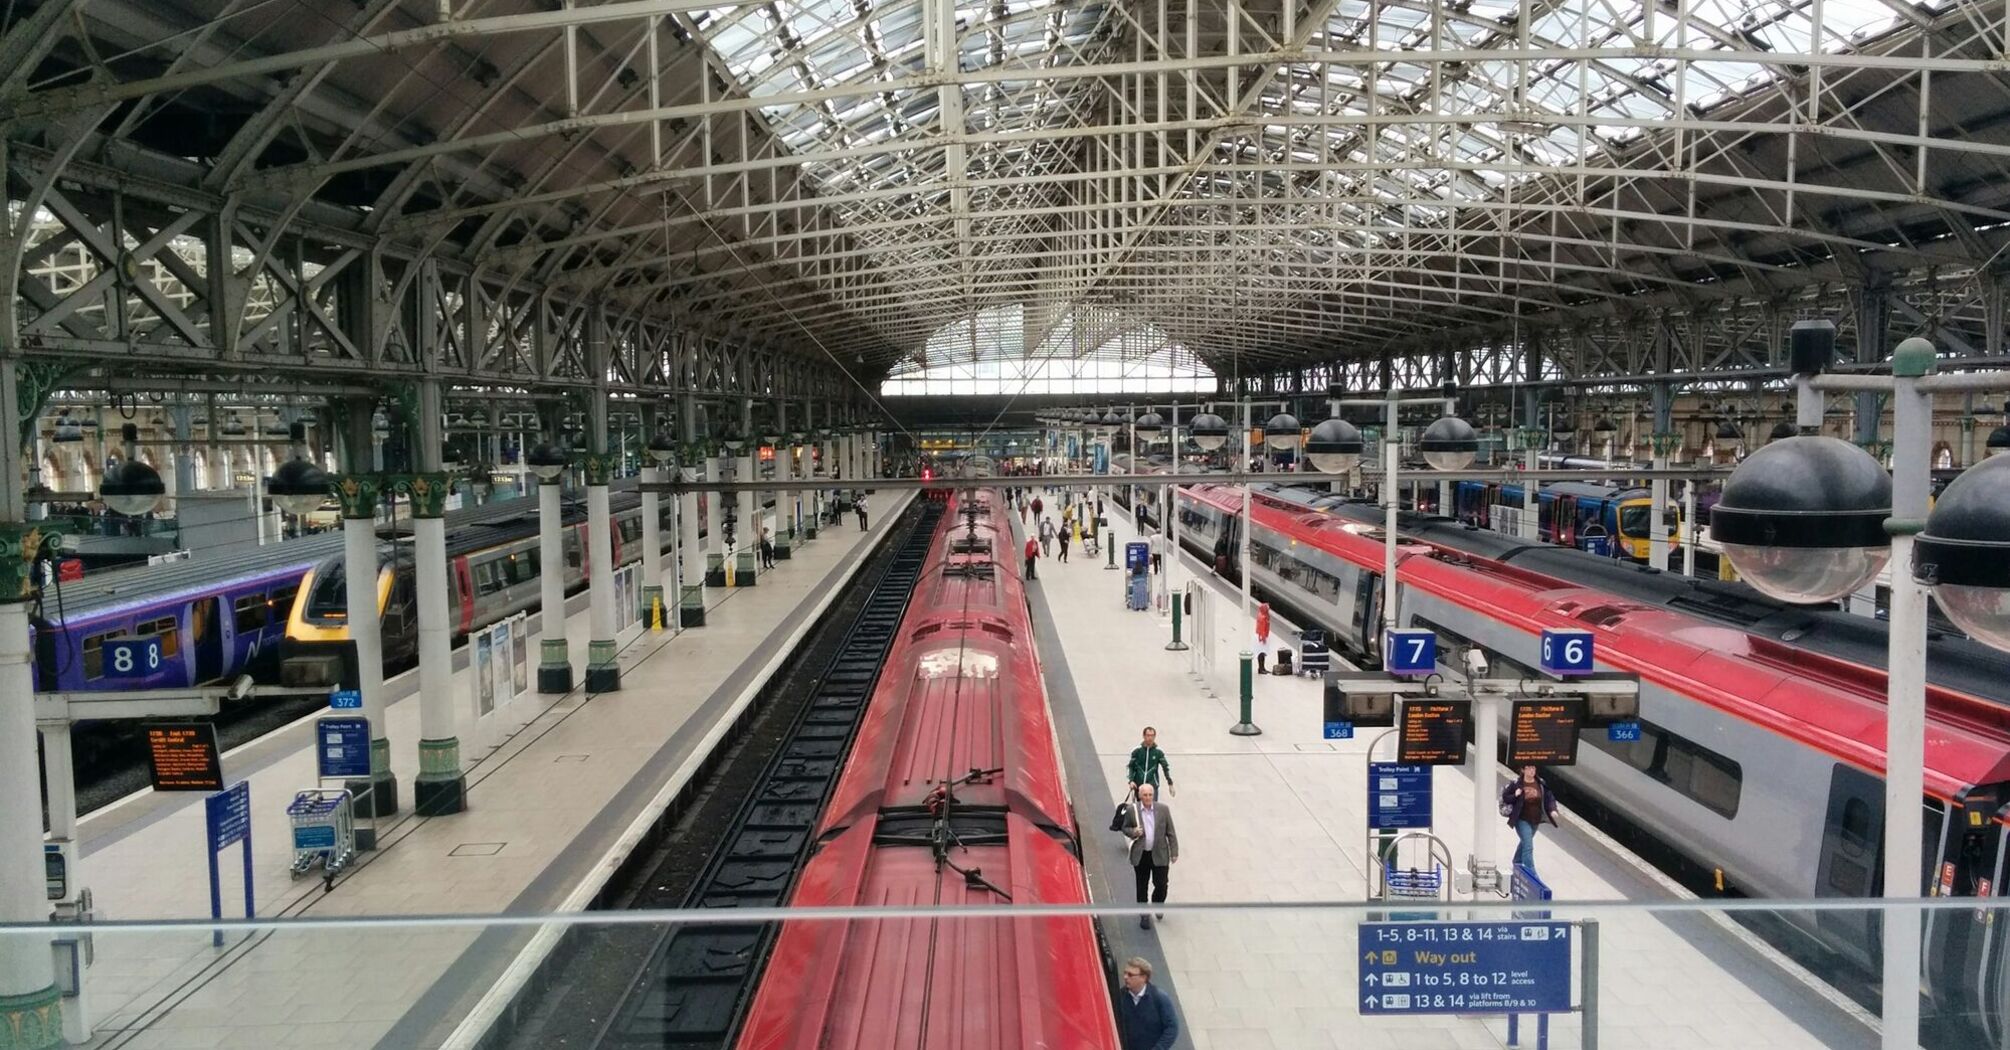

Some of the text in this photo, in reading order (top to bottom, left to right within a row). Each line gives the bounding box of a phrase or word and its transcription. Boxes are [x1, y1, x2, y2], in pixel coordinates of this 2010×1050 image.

[149, 643, 158, 668] 8
[1408, 639, 1426, 664] 7
[1544, 637, 1552, 661] 6
[1564, 640, 1584, 664] 6
[114, 646, 134, 672] 8
[337, 698, 354, 706] 372
[1330, 729, 1348, 737] 368
[1616, 730, 1634, 739] 366
[1981, 882, 1988, 892] F
[1443, 929, 1458, 941] 13
[1462, 929, 1473, 941] &
[1477, 928, 1493, 940] 14
[1414, 952, 1476, 966] Way out
[1415, 972, 1507, 986] 1 to 5, 8 to 12
[1415, 995, 1464, 1007] 13 & 14
